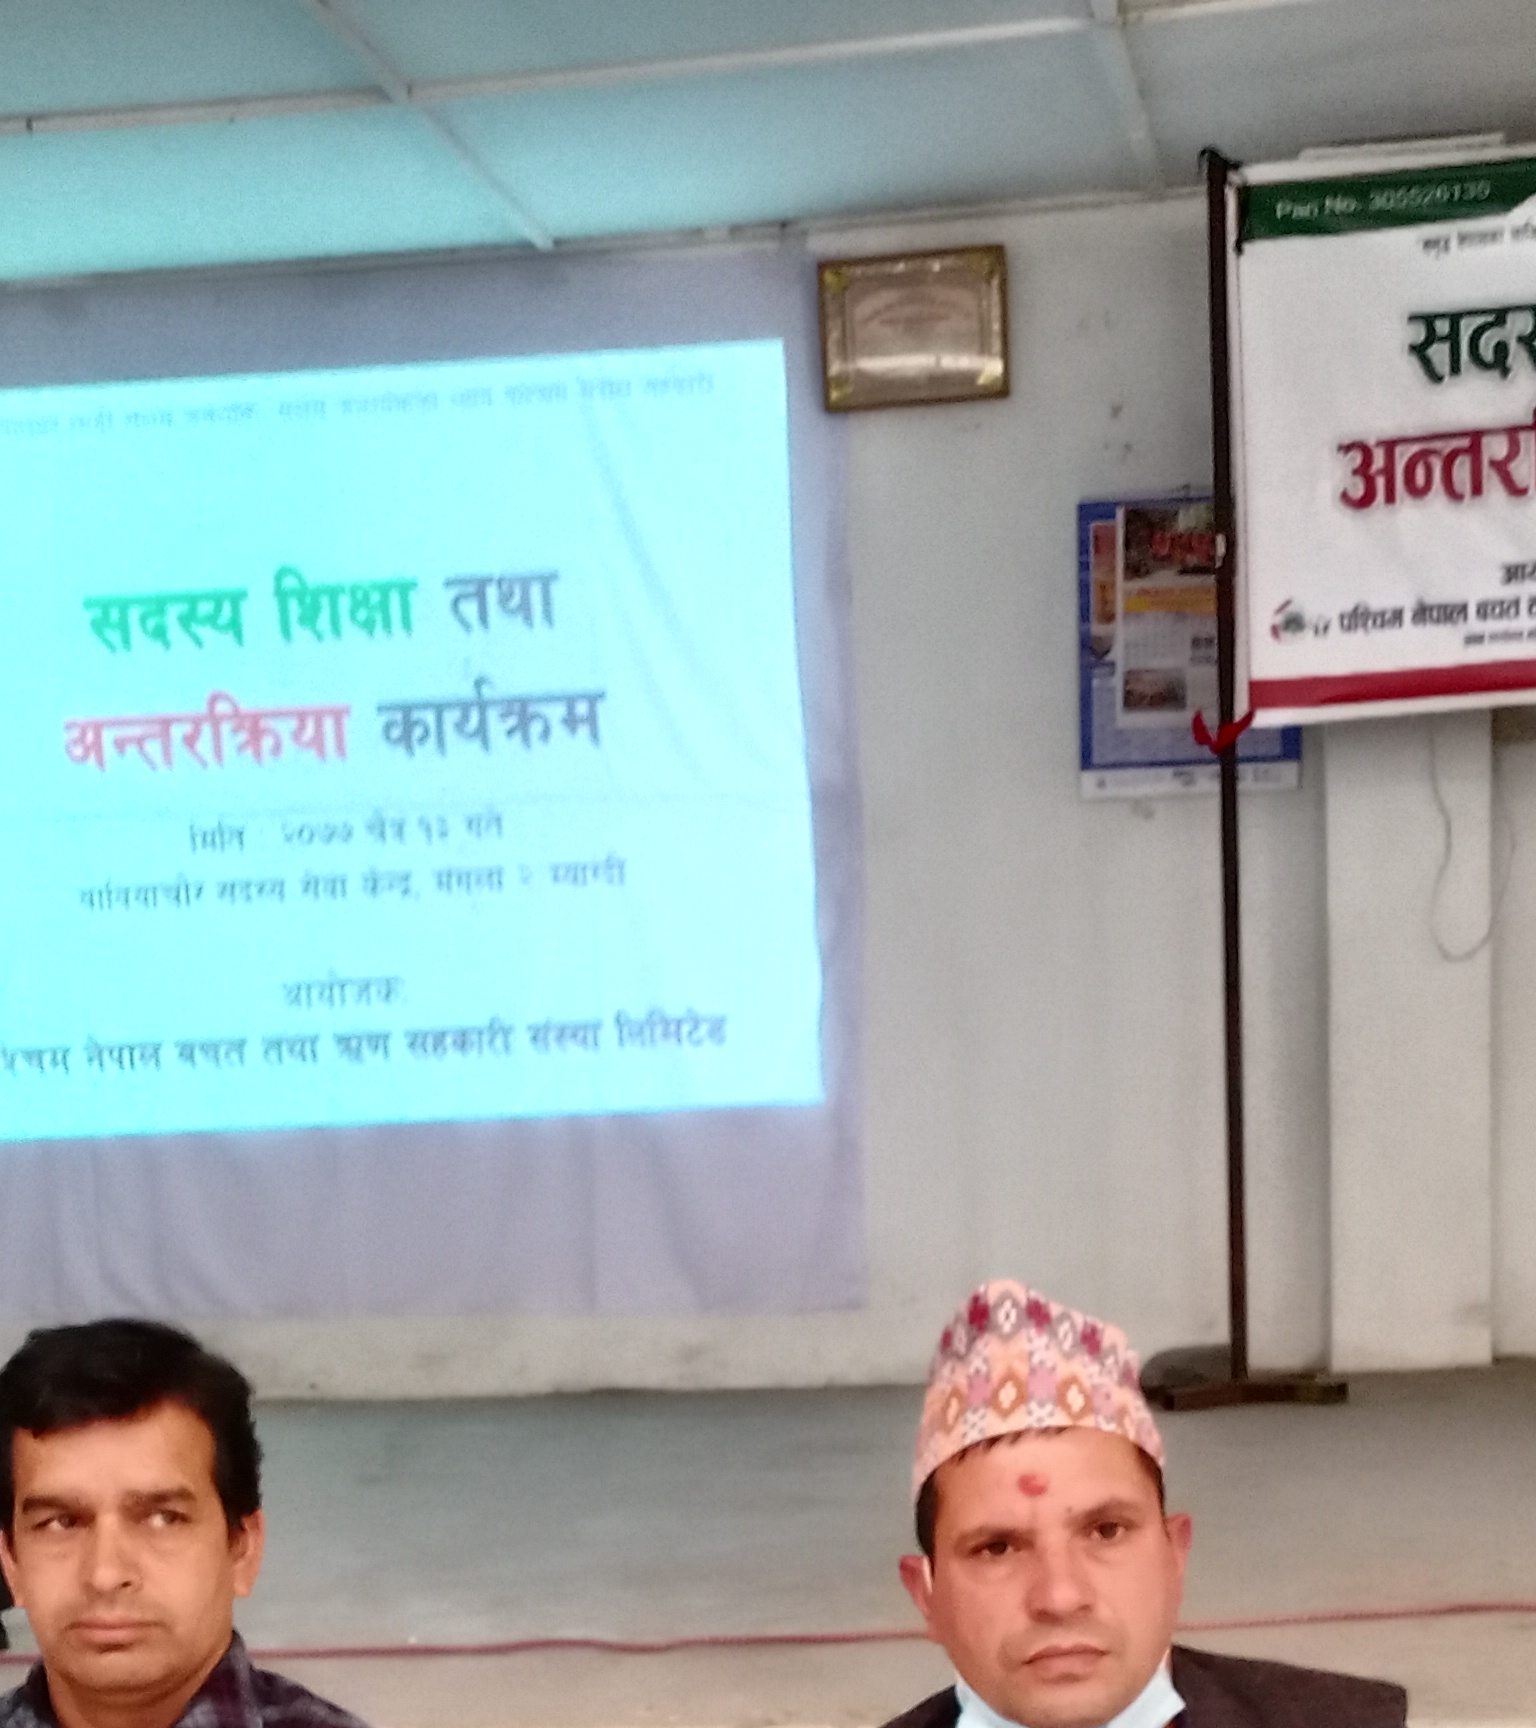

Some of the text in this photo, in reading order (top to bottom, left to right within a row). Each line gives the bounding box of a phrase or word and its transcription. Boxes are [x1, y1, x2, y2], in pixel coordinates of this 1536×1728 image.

[82, 563, 560, 653] सदस्य शिक्षा तथा
[1411, 599, 1469, 626] नेपाल
[64, 673, 607, 770] अन्तरक्रिया कार्यक्रम
[82, 1033, 164, 1073] नेपाल
[261, 1033, 320, 1065] तथा
[403, 1016, 514, 1056] सहकारी
